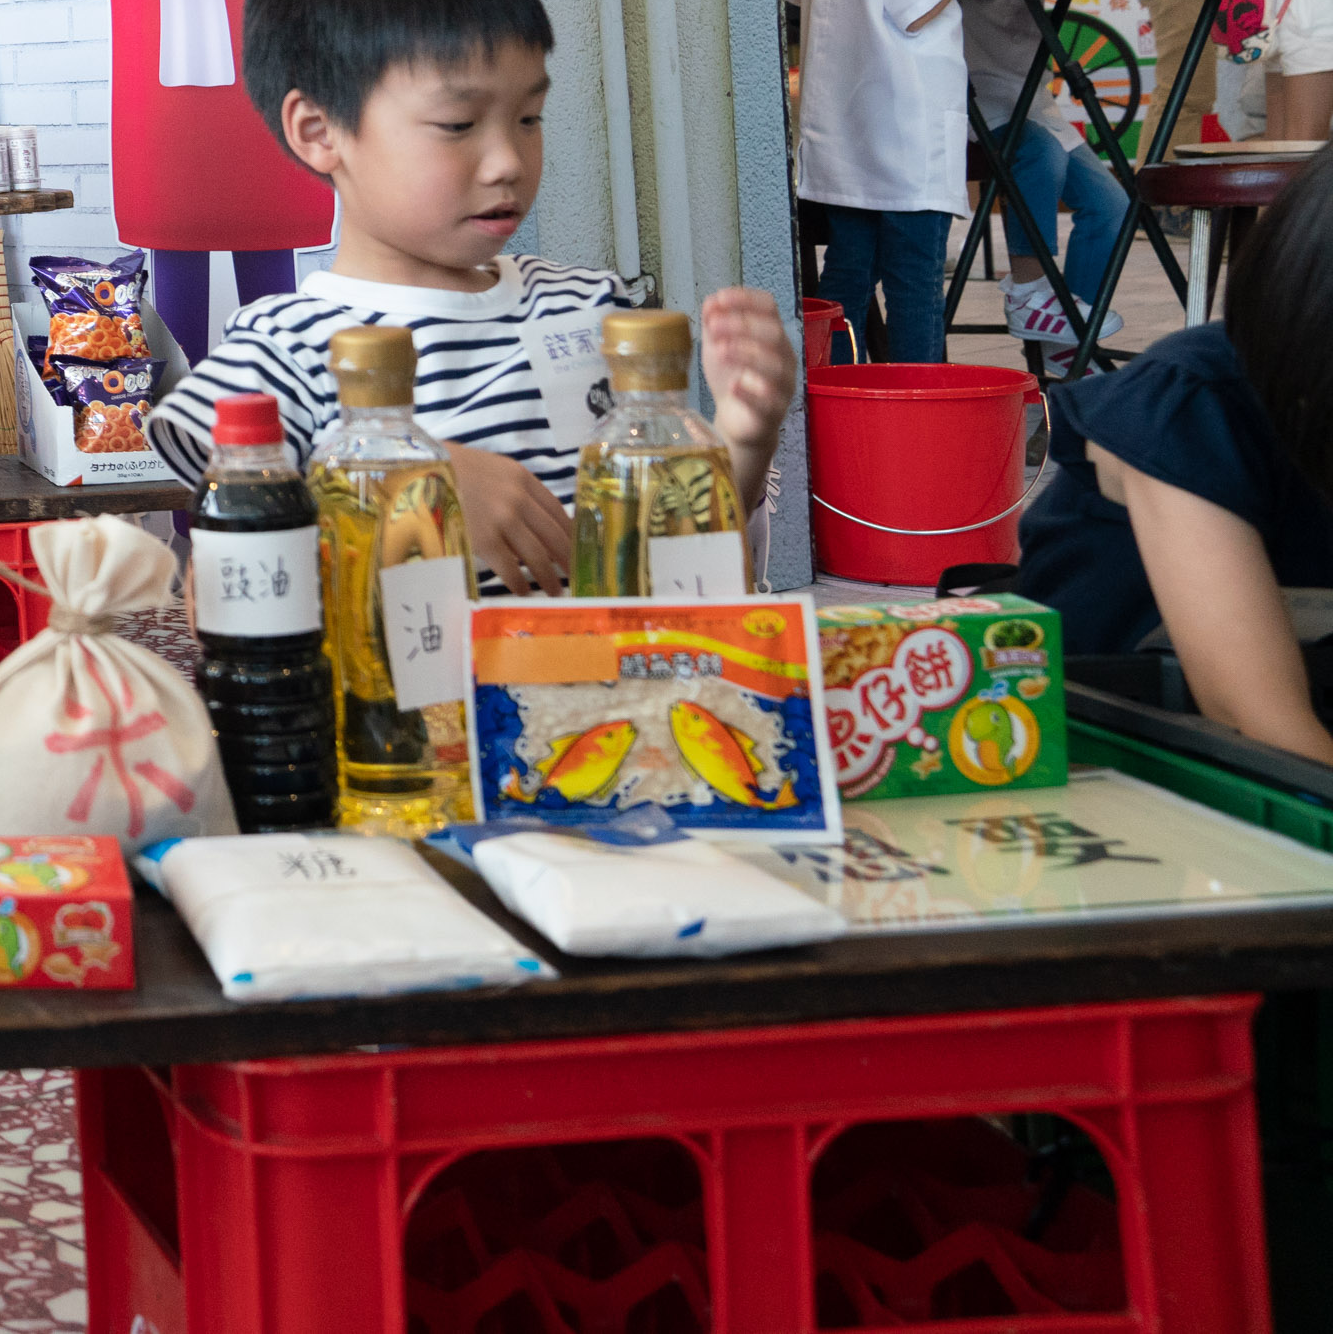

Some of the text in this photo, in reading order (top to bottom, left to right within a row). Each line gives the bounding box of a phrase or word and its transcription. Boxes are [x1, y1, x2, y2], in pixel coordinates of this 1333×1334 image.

[219, 558, 291, 605] 豉油
[406, 602, 444, 661] 油
[44, 649, 196, 839] 米
